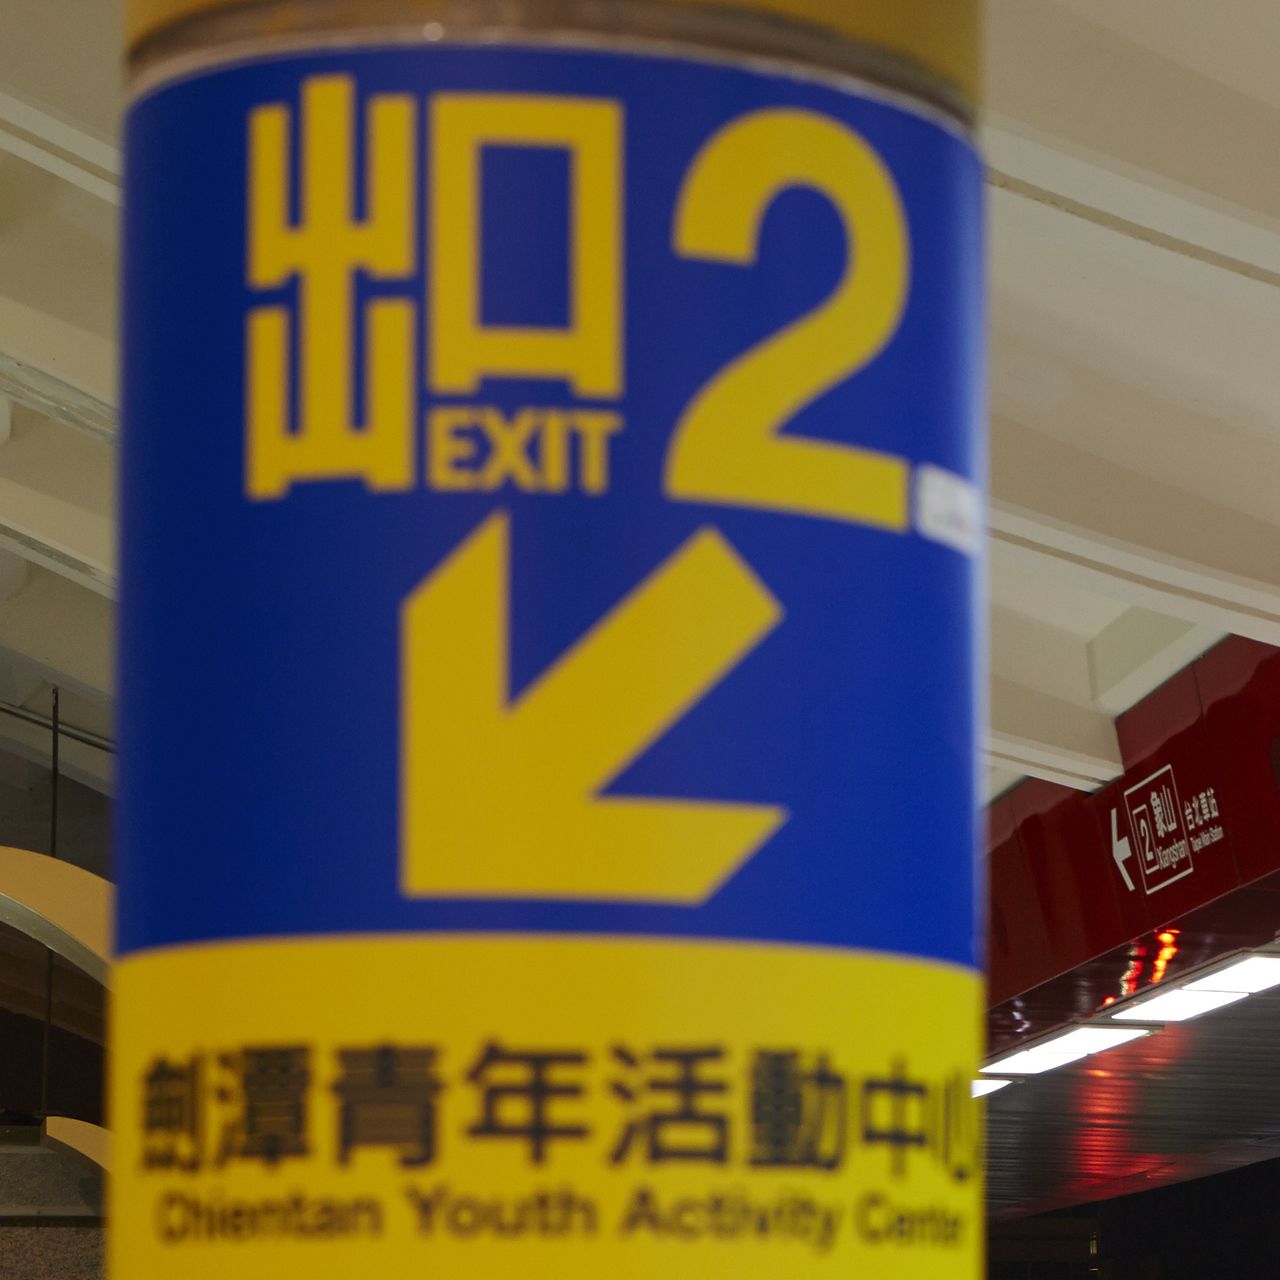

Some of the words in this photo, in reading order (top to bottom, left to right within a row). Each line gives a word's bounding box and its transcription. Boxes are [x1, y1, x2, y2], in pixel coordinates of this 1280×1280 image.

[245, 74, 624, 499] 出口
[665, 107, 911, 531] 2
[429, 407, 622, 494] EXIT
[1140, 818, 1154, 862] 2
[1151, 785, 1177, 838] 象山
[406, 1184, 598, 1240] Youth
[622, 1186, 838, 1255] Activity
